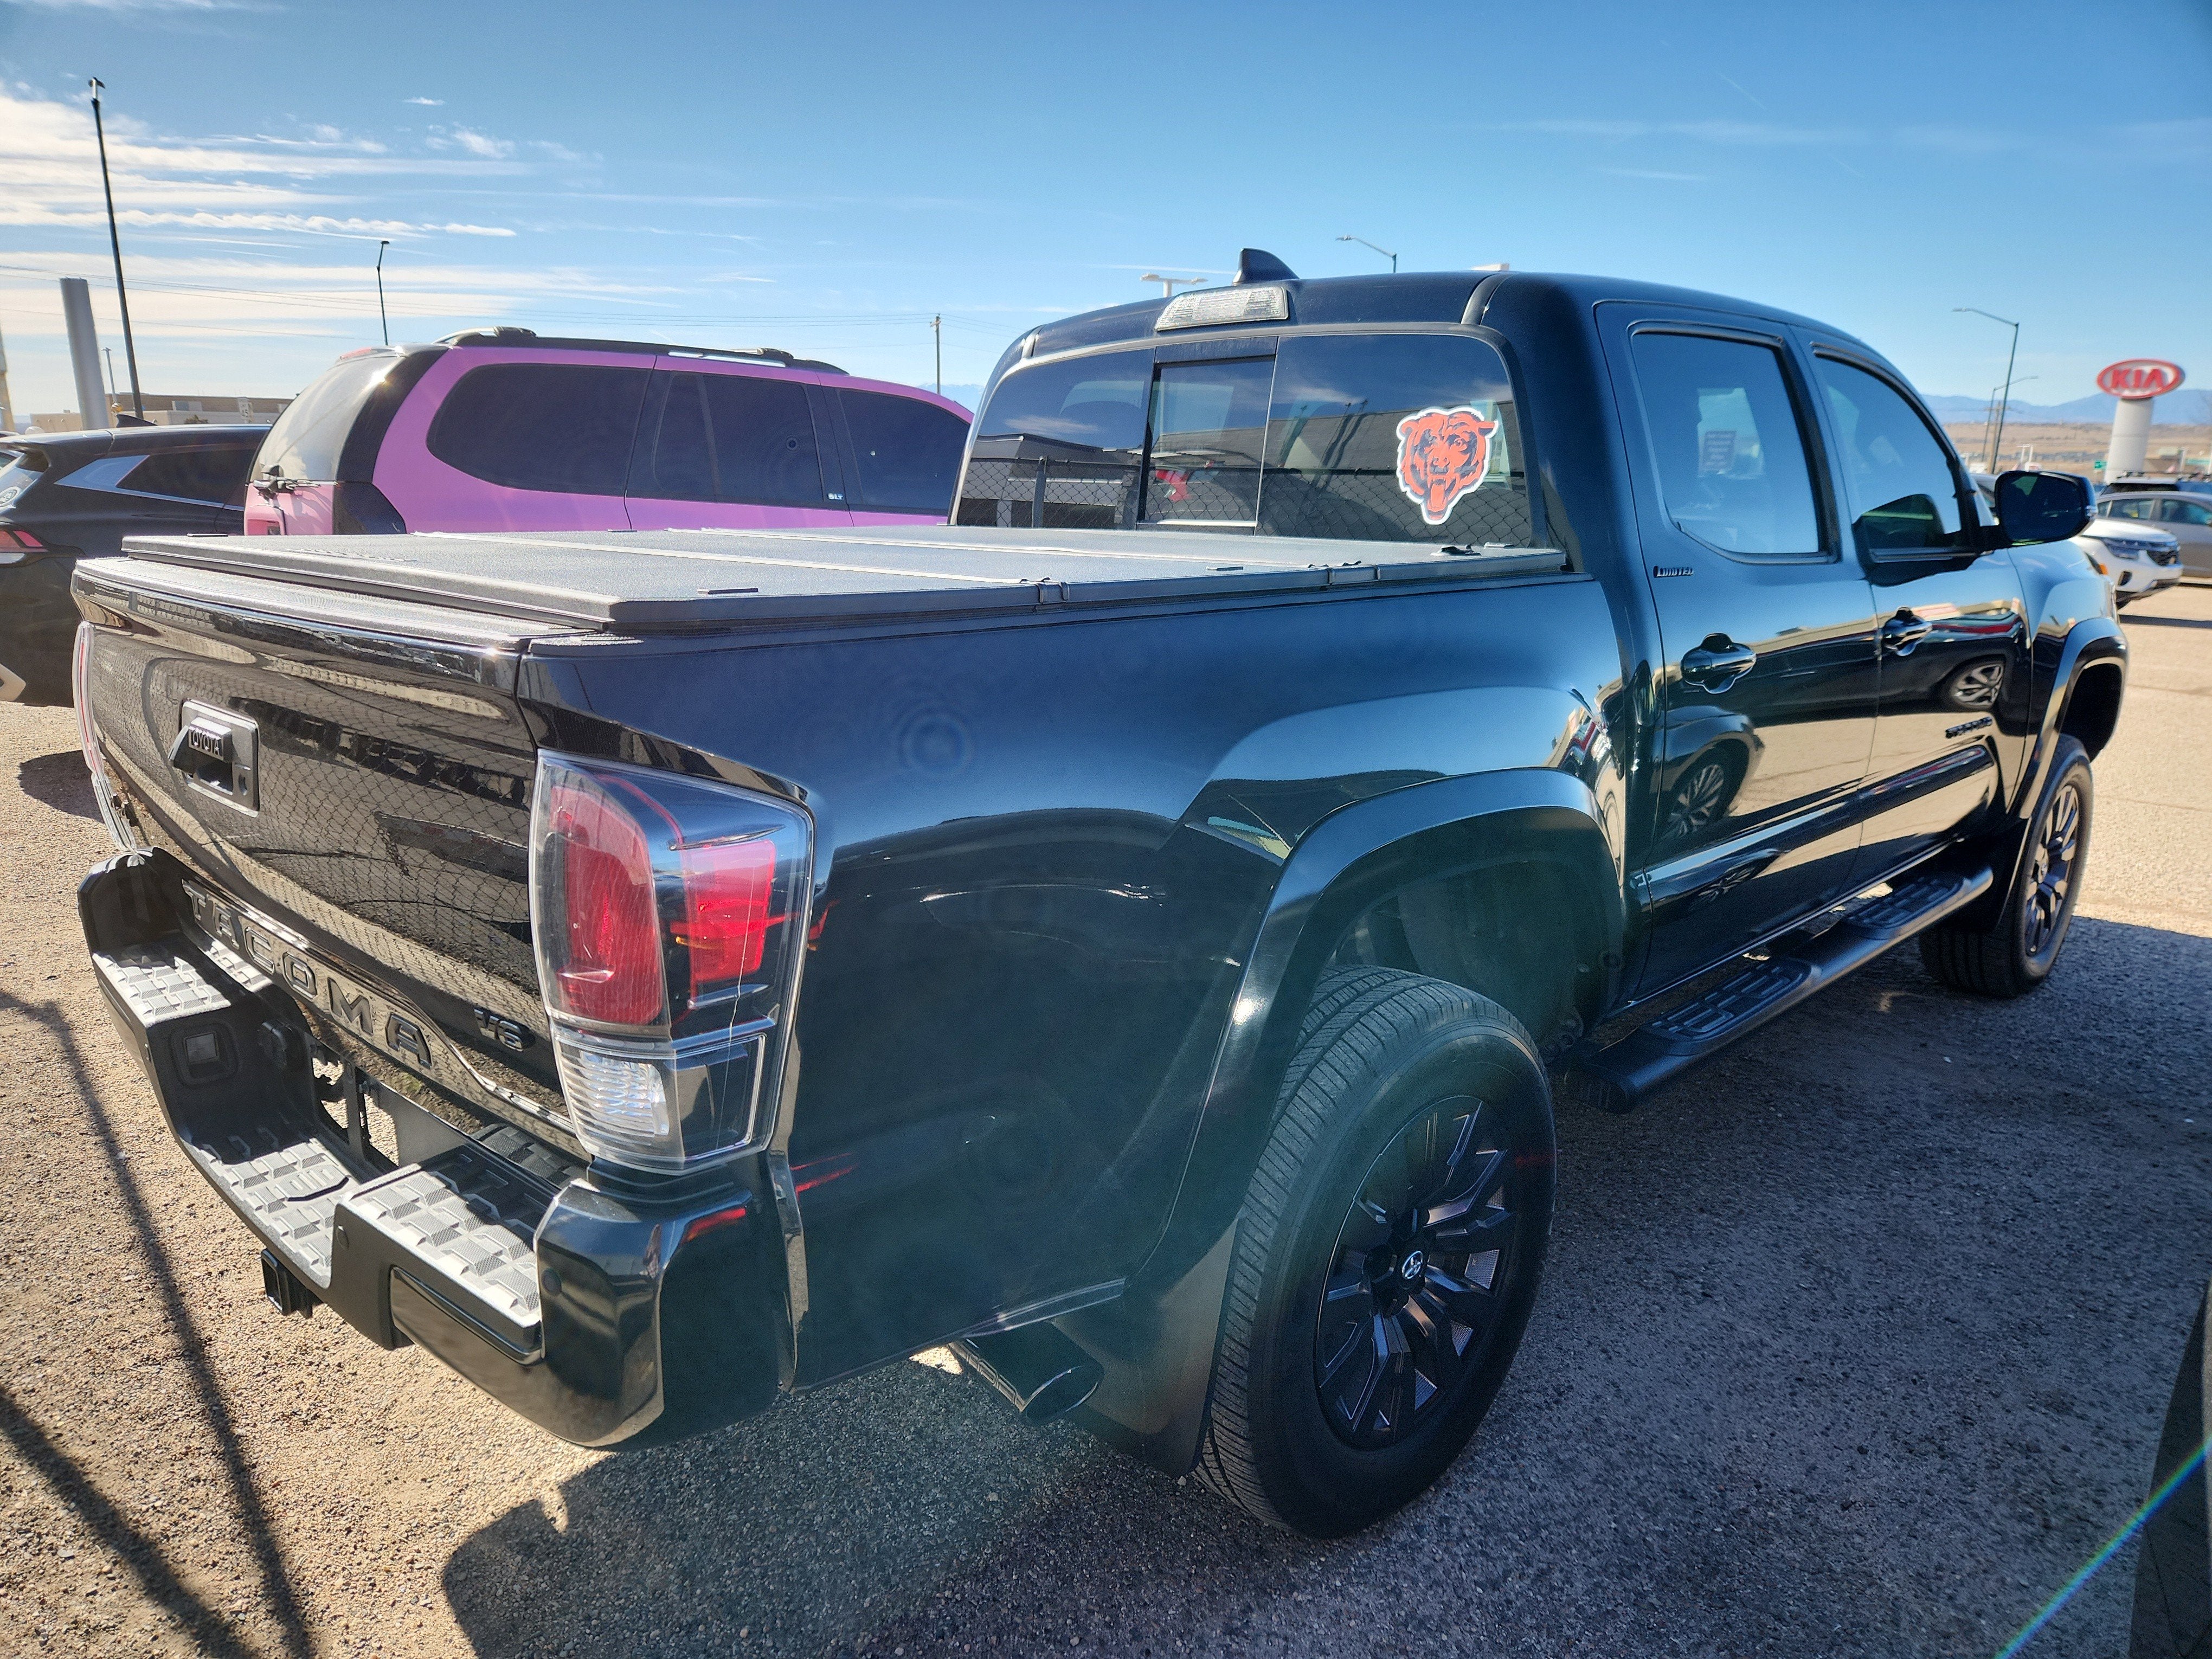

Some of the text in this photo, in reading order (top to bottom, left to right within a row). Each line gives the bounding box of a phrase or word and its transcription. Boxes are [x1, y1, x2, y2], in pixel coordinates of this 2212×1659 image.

[2110, 368, 2166, 389] KIA
[189, 727, 223, 757] TOYOTA
[182, 879, 432, 1070] TACOMA
[473, 1007, 531, 1052] V6
